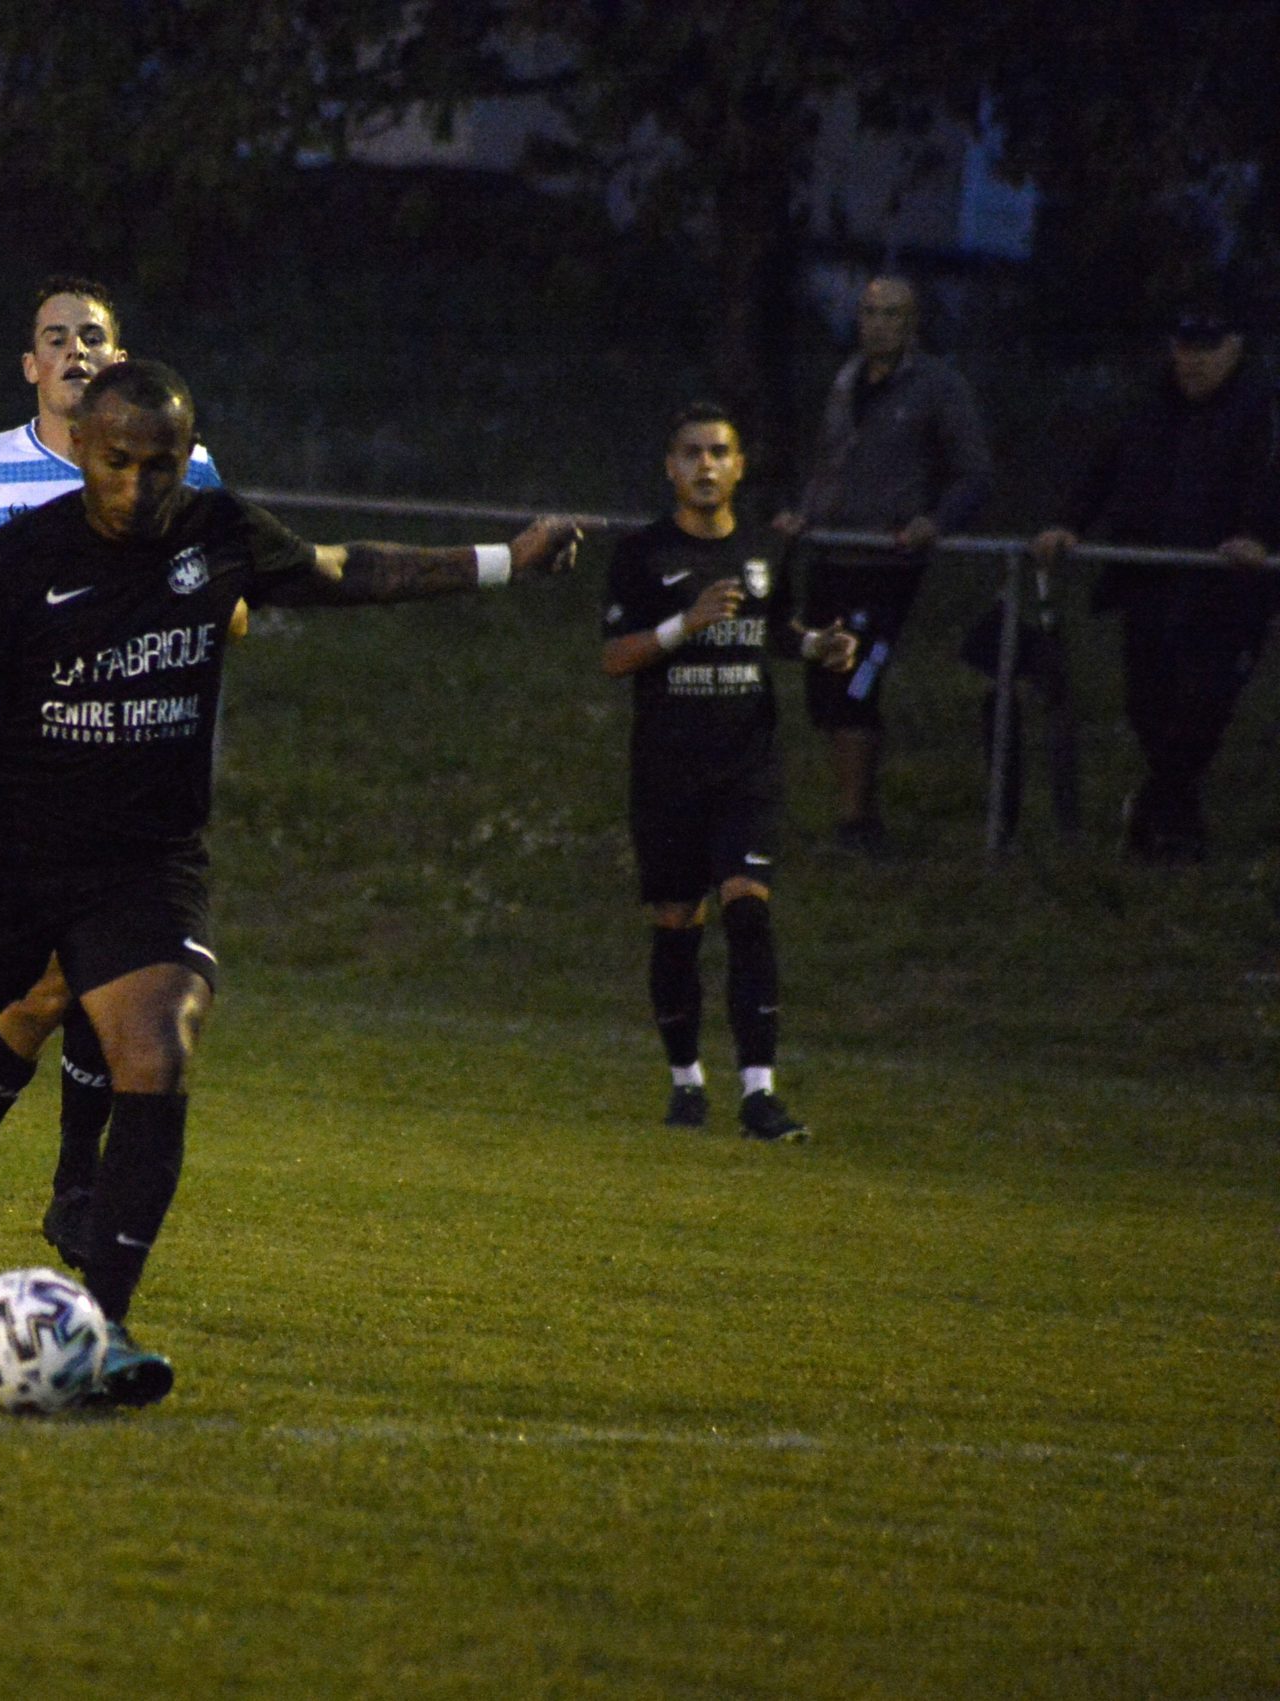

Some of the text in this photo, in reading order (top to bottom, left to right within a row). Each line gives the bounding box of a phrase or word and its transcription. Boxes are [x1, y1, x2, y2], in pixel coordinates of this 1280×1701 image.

[52, 623, 216, 686] LA FABRIQUE
[41, 693, 200, 728] CENTRE THERMAL
